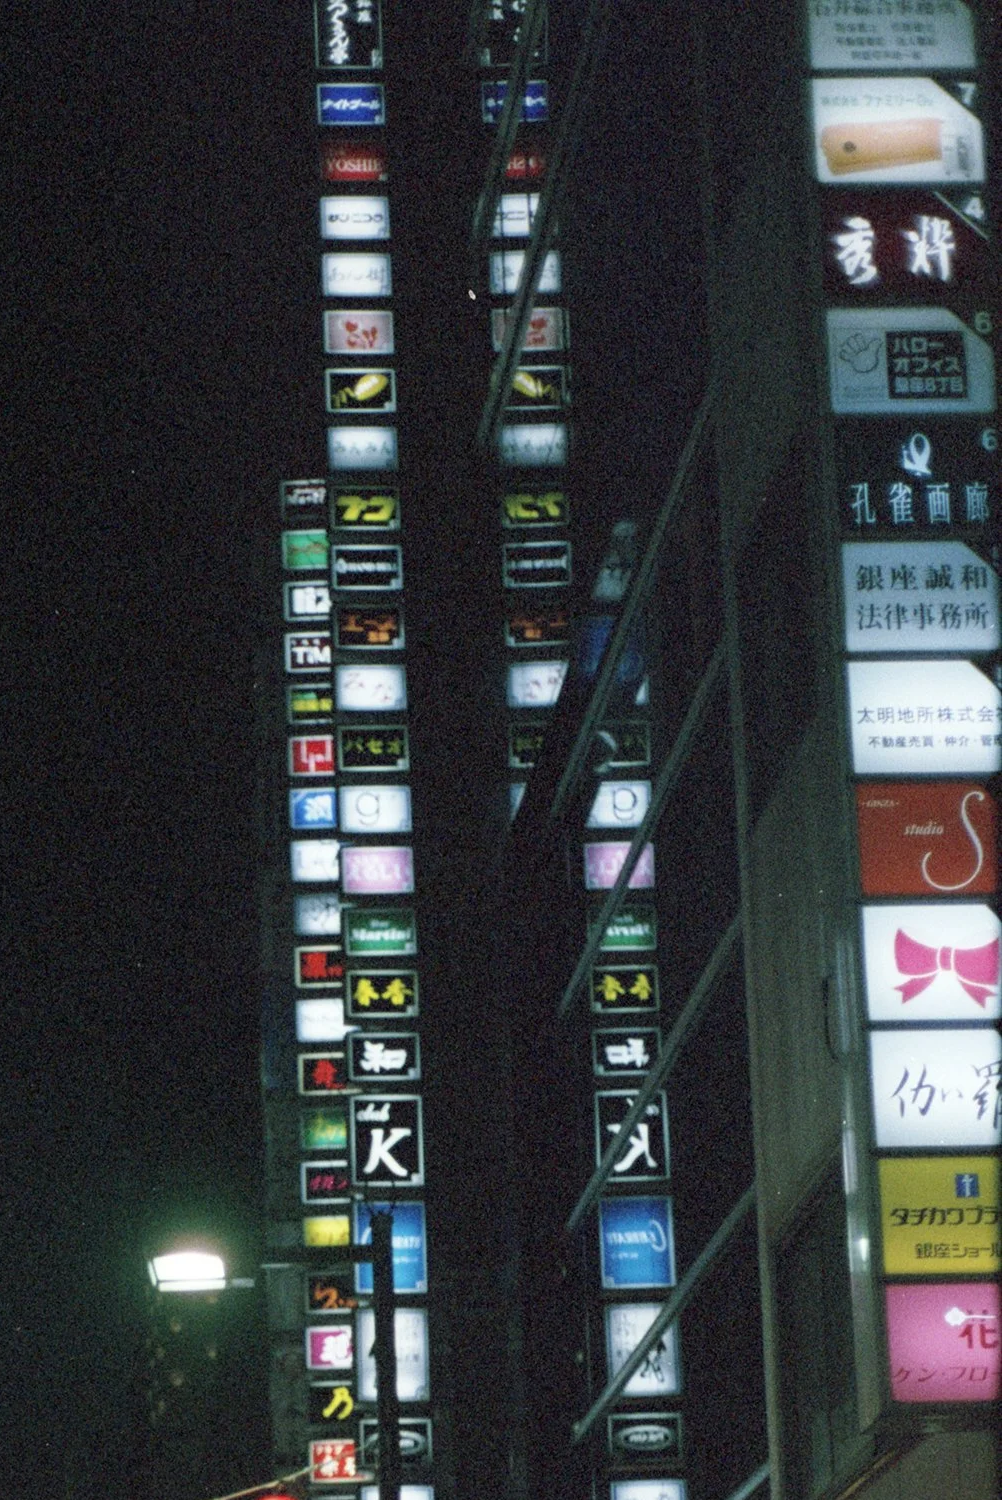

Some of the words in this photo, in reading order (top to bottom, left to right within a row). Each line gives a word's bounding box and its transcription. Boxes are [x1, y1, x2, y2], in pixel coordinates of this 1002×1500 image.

[975, 312, 993, 335] 6
[892, 337, 944, 354] ハロー
[892, 356, 962, 373] オフィス
[981, 428, 998, 452] 6
[850, 481, 990, 525] 孔雀画廊
[855, 563, 988, 592] 銀座誠和
[856, 602, 989, 631] 法律事務所
[903, 819, 945, 836] studio
[921, 790, 985, 891] S
[363, 1128, 412, 1177] K
